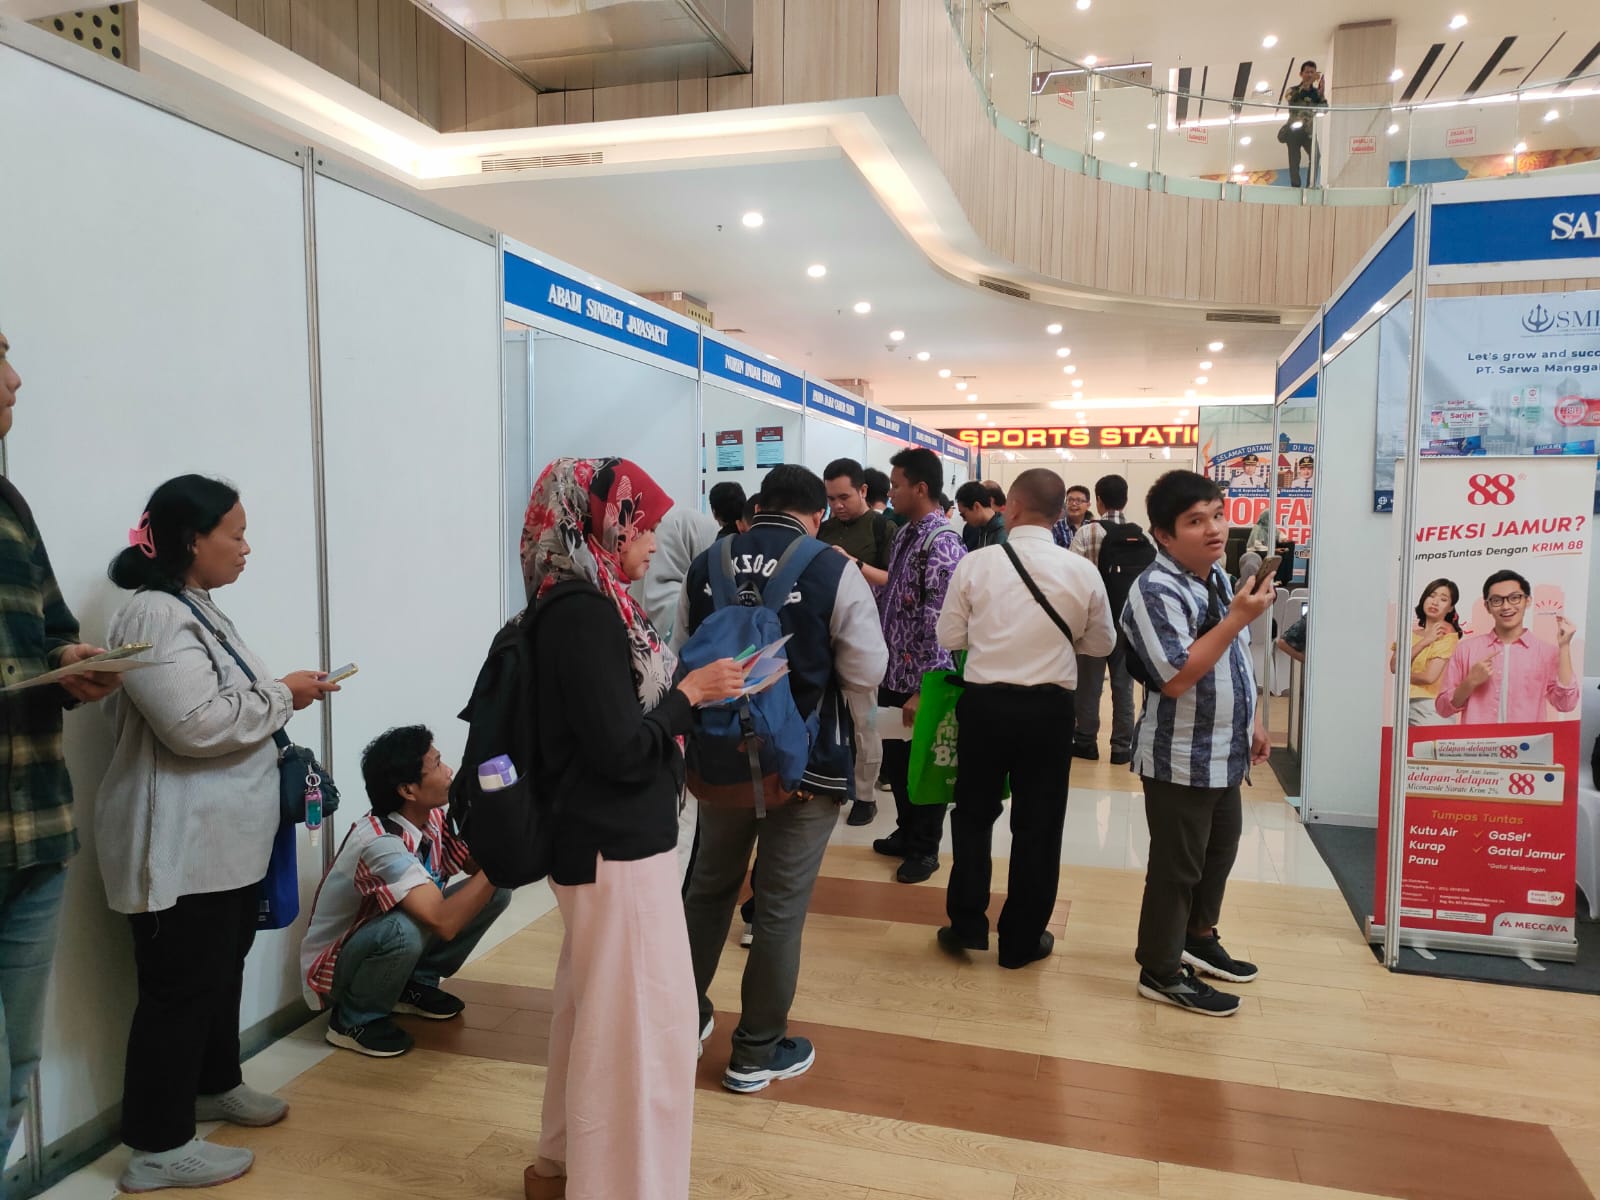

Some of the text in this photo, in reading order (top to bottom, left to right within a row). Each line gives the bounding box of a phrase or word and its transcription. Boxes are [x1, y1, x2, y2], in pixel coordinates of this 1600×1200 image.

[548, 284, 668, 346] ABADI SINERGI JAYASAKTI
[1468, 352, 1498, 361] Let's
[1503, 353, 1536, 362] grow
[1542, 349, 1567, 358] and
[1476, 365, 1494, 374] PT.
[1499, 364, 1539, 374] Sarwa
[959, 428, 1090, 447] SPORTS
[1216, 448, 1245, 462] SELAMAT
[1467, 473, 1516, 505] 88
[1276, 498, 1313, 526] FA
[1416, 515, 1586, 542] NFEKSI JAMUR?
[1486, 546, 1528, 557] Dengan
[1532, 542, 1564, 552] KRIM
[1567, 540, 1583, 550] 88
[1499, 744, 1518, 759] 88
[1508, 772, 1535, 795] 88
[1431, 810, 1524, 825] Tumpas Tuntas
[1409, 825, 1458, 837] Kutu Air
[1409, 840, 1446, 854] Kurap
[1488, 846, 1566, 861] Gatal Jamur
[1408, 855, 1439, 866] Panu
[1515, 920, 1569, 933] MECCAYA
